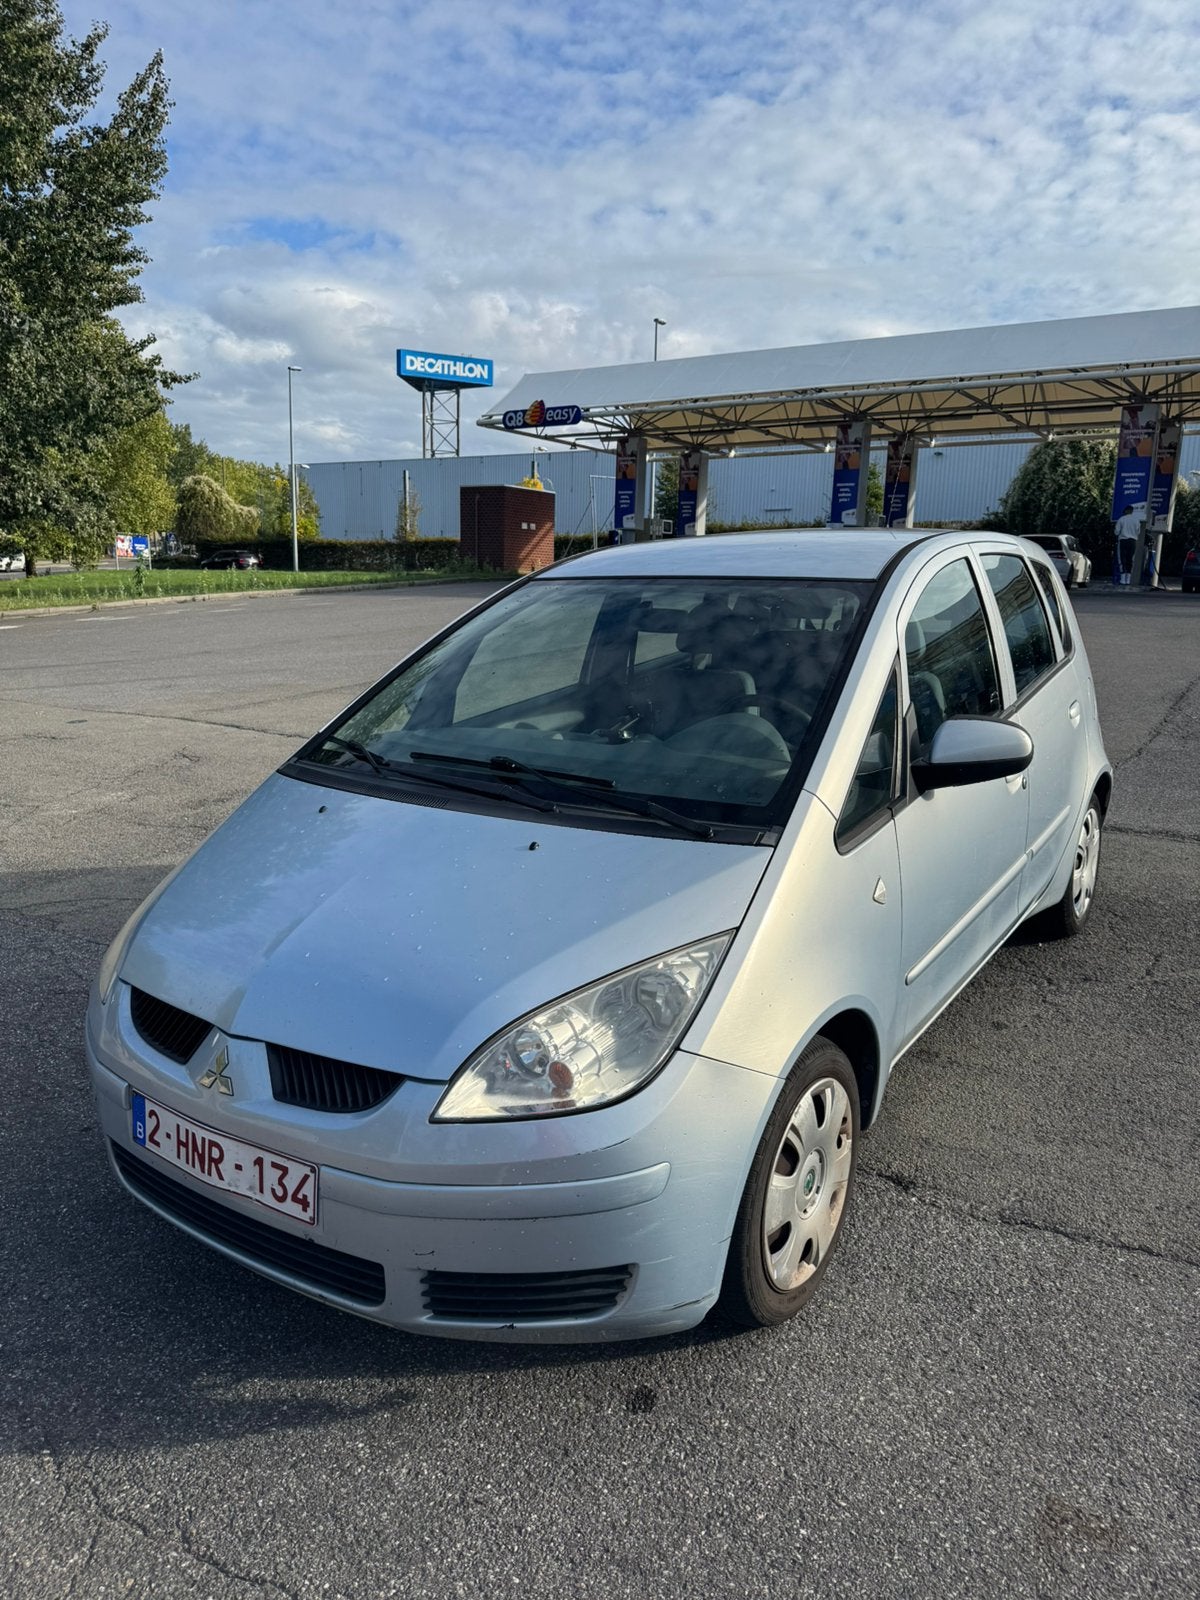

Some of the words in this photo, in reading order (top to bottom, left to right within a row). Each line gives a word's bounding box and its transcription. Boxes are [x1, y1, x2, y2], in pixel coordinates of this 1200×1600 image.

[406, 355, 489, 380] DECATHLON
[505, 411, 524, 427] Q8
[546, 406, 578, 424] easy
[136, 1121, 144, 1139] B
[148, 1109, 310, 1213] 2-HNR-134
